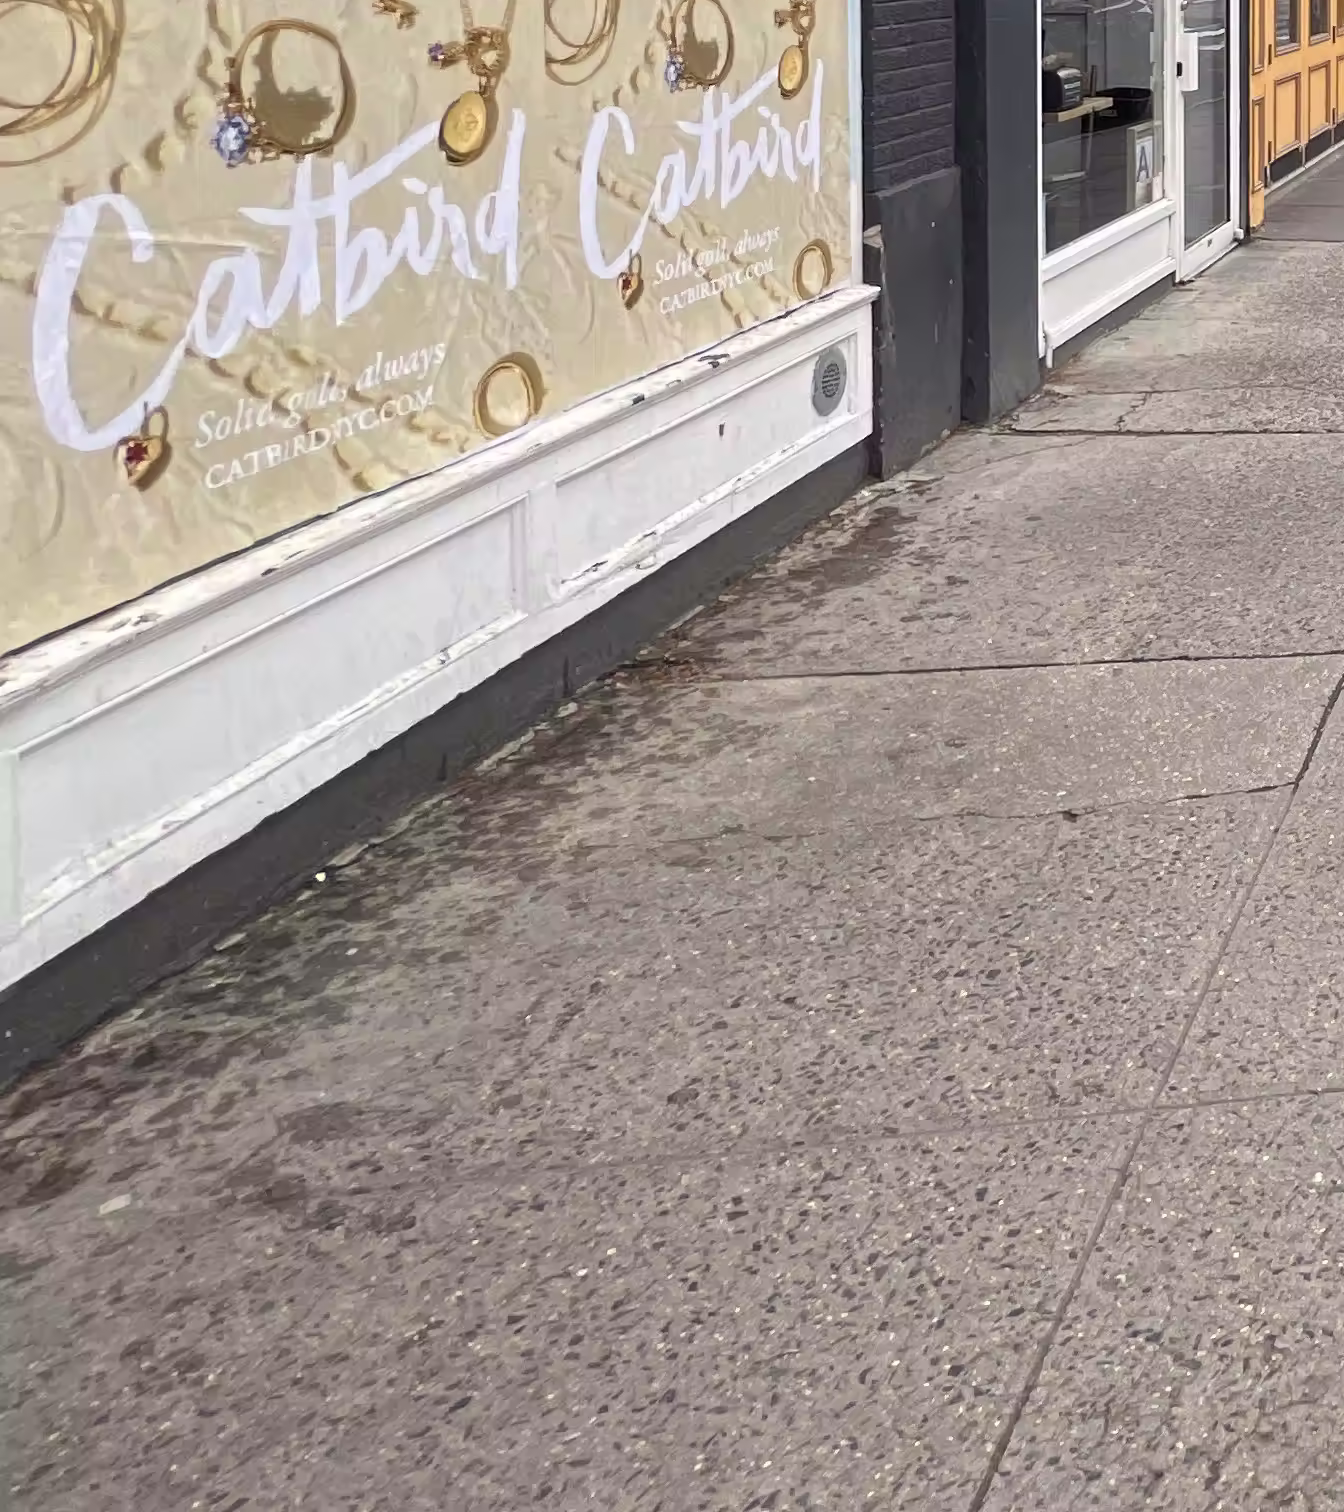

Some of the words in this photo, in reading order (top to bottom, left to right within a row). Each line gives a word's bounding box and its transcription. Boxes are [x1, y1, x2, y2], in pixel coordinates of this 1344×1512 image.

[578, 59, 824, 279] Catbird
[1136, 145, 1150, 182] A
[32, 108, 527, 454] Catbird
[194, 396, 273, 450] Solid
[355, 342, 446, 392] always
[203, 384, 435, 490] CATBIRDNYC.COM
